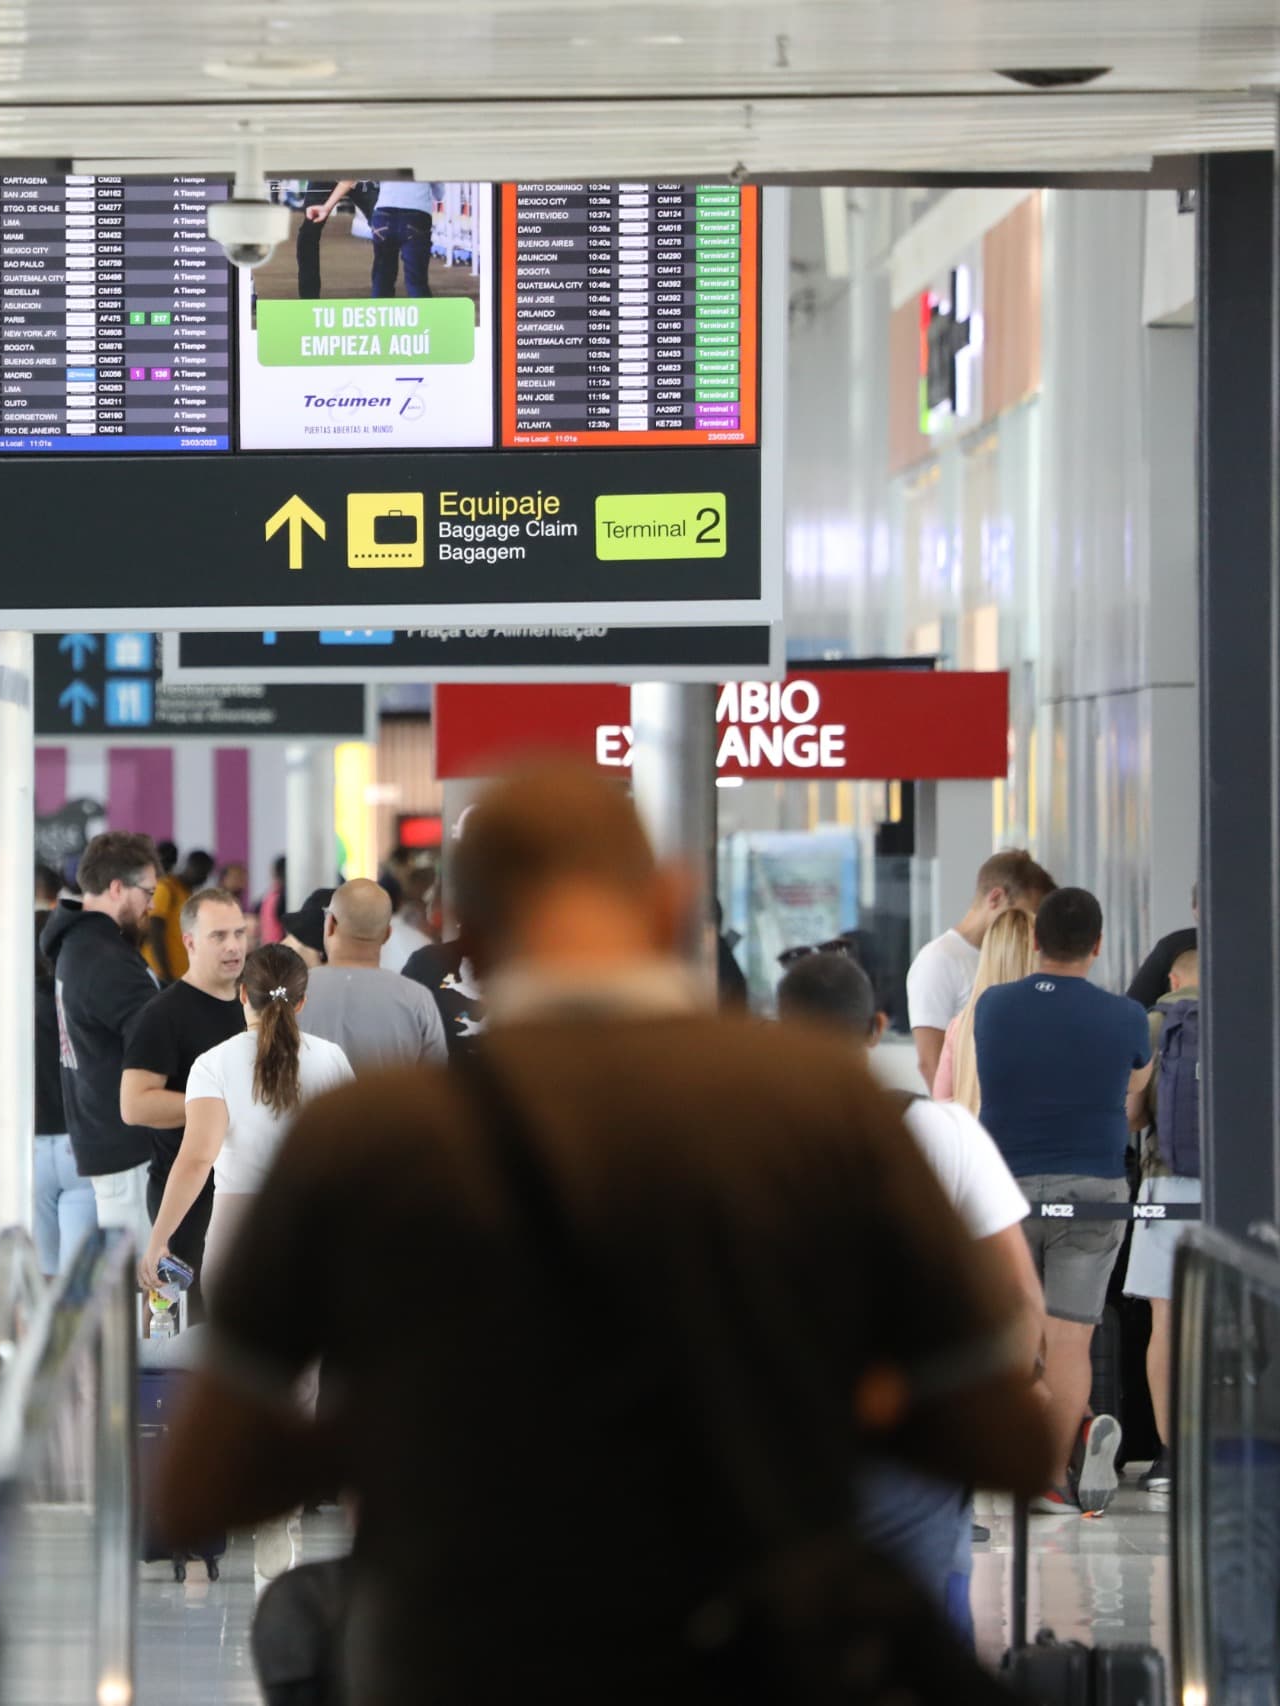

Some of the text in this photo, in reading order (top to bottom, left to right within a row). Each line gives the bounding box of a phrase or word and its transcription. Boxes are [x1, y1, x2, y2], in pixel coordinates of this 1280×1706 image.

[3, 176, 48, 184] CARTAGENA
[518, 184, 583, 192] SANTO DOMINGO
[518, 198, 548, 206] MEXICO
[549, 198, 567, 206] CITY
[700, 196, 729, 204] Terminal
[3, 204, 26, 212] STGO.
[39, 204, 60, 212] CHILE
[180, 203, 206, 212] Tiempo
[518, 212, 569, 220] MONTEVIDEO
[700, 210, 729, 218] Terminal
[518, 226, 542, 234] DAVID
[518, 240, 574, 248] BUENOS AIRES
[517, 254, 558, 262] ASUNCION
[517, 268, 550, 276] BOGOTA
[4, 274, 64, 282] GUATEMALA CITY
[517, 282, 583, 290] GUATEMALA CITY
[312, 306, 419, 328] TU DESTINO
[517, 310, 555, 318] ORLANDO
[4, 316, 25, 324] PARIS
[517, 324, 564, 332] CARTAGENA
[4, 330, 57, 338] NEW YORK JFK
[301, 328, 430, 356] EMPIEZA AQUÍ
[517, 366, 554, 374] SAN JOSE
[4, 372, 32, 380] MADRID
[517, 380, 555, 388] MEDELLIN
[4, 400, 27, 408] QUITO
[304, 395, 391, 408] Tocumen
[517, 420, 551, 430] ATLANTA
[699, 418, 728, 428] Terminal
[4, 426, 18, 434] RIO
[30, 426, 61, 434] JANEIRO
[304, 425, 394, 434] PUERTAS ABIERTAS AL MUNDO
[439, 491, 560, 521] Equipaje
[603, 507, 721, 544] Terminal 2
[438, 520, 578, 541] Baggage Claim
[438, 543, 526, 564] Bagagem
